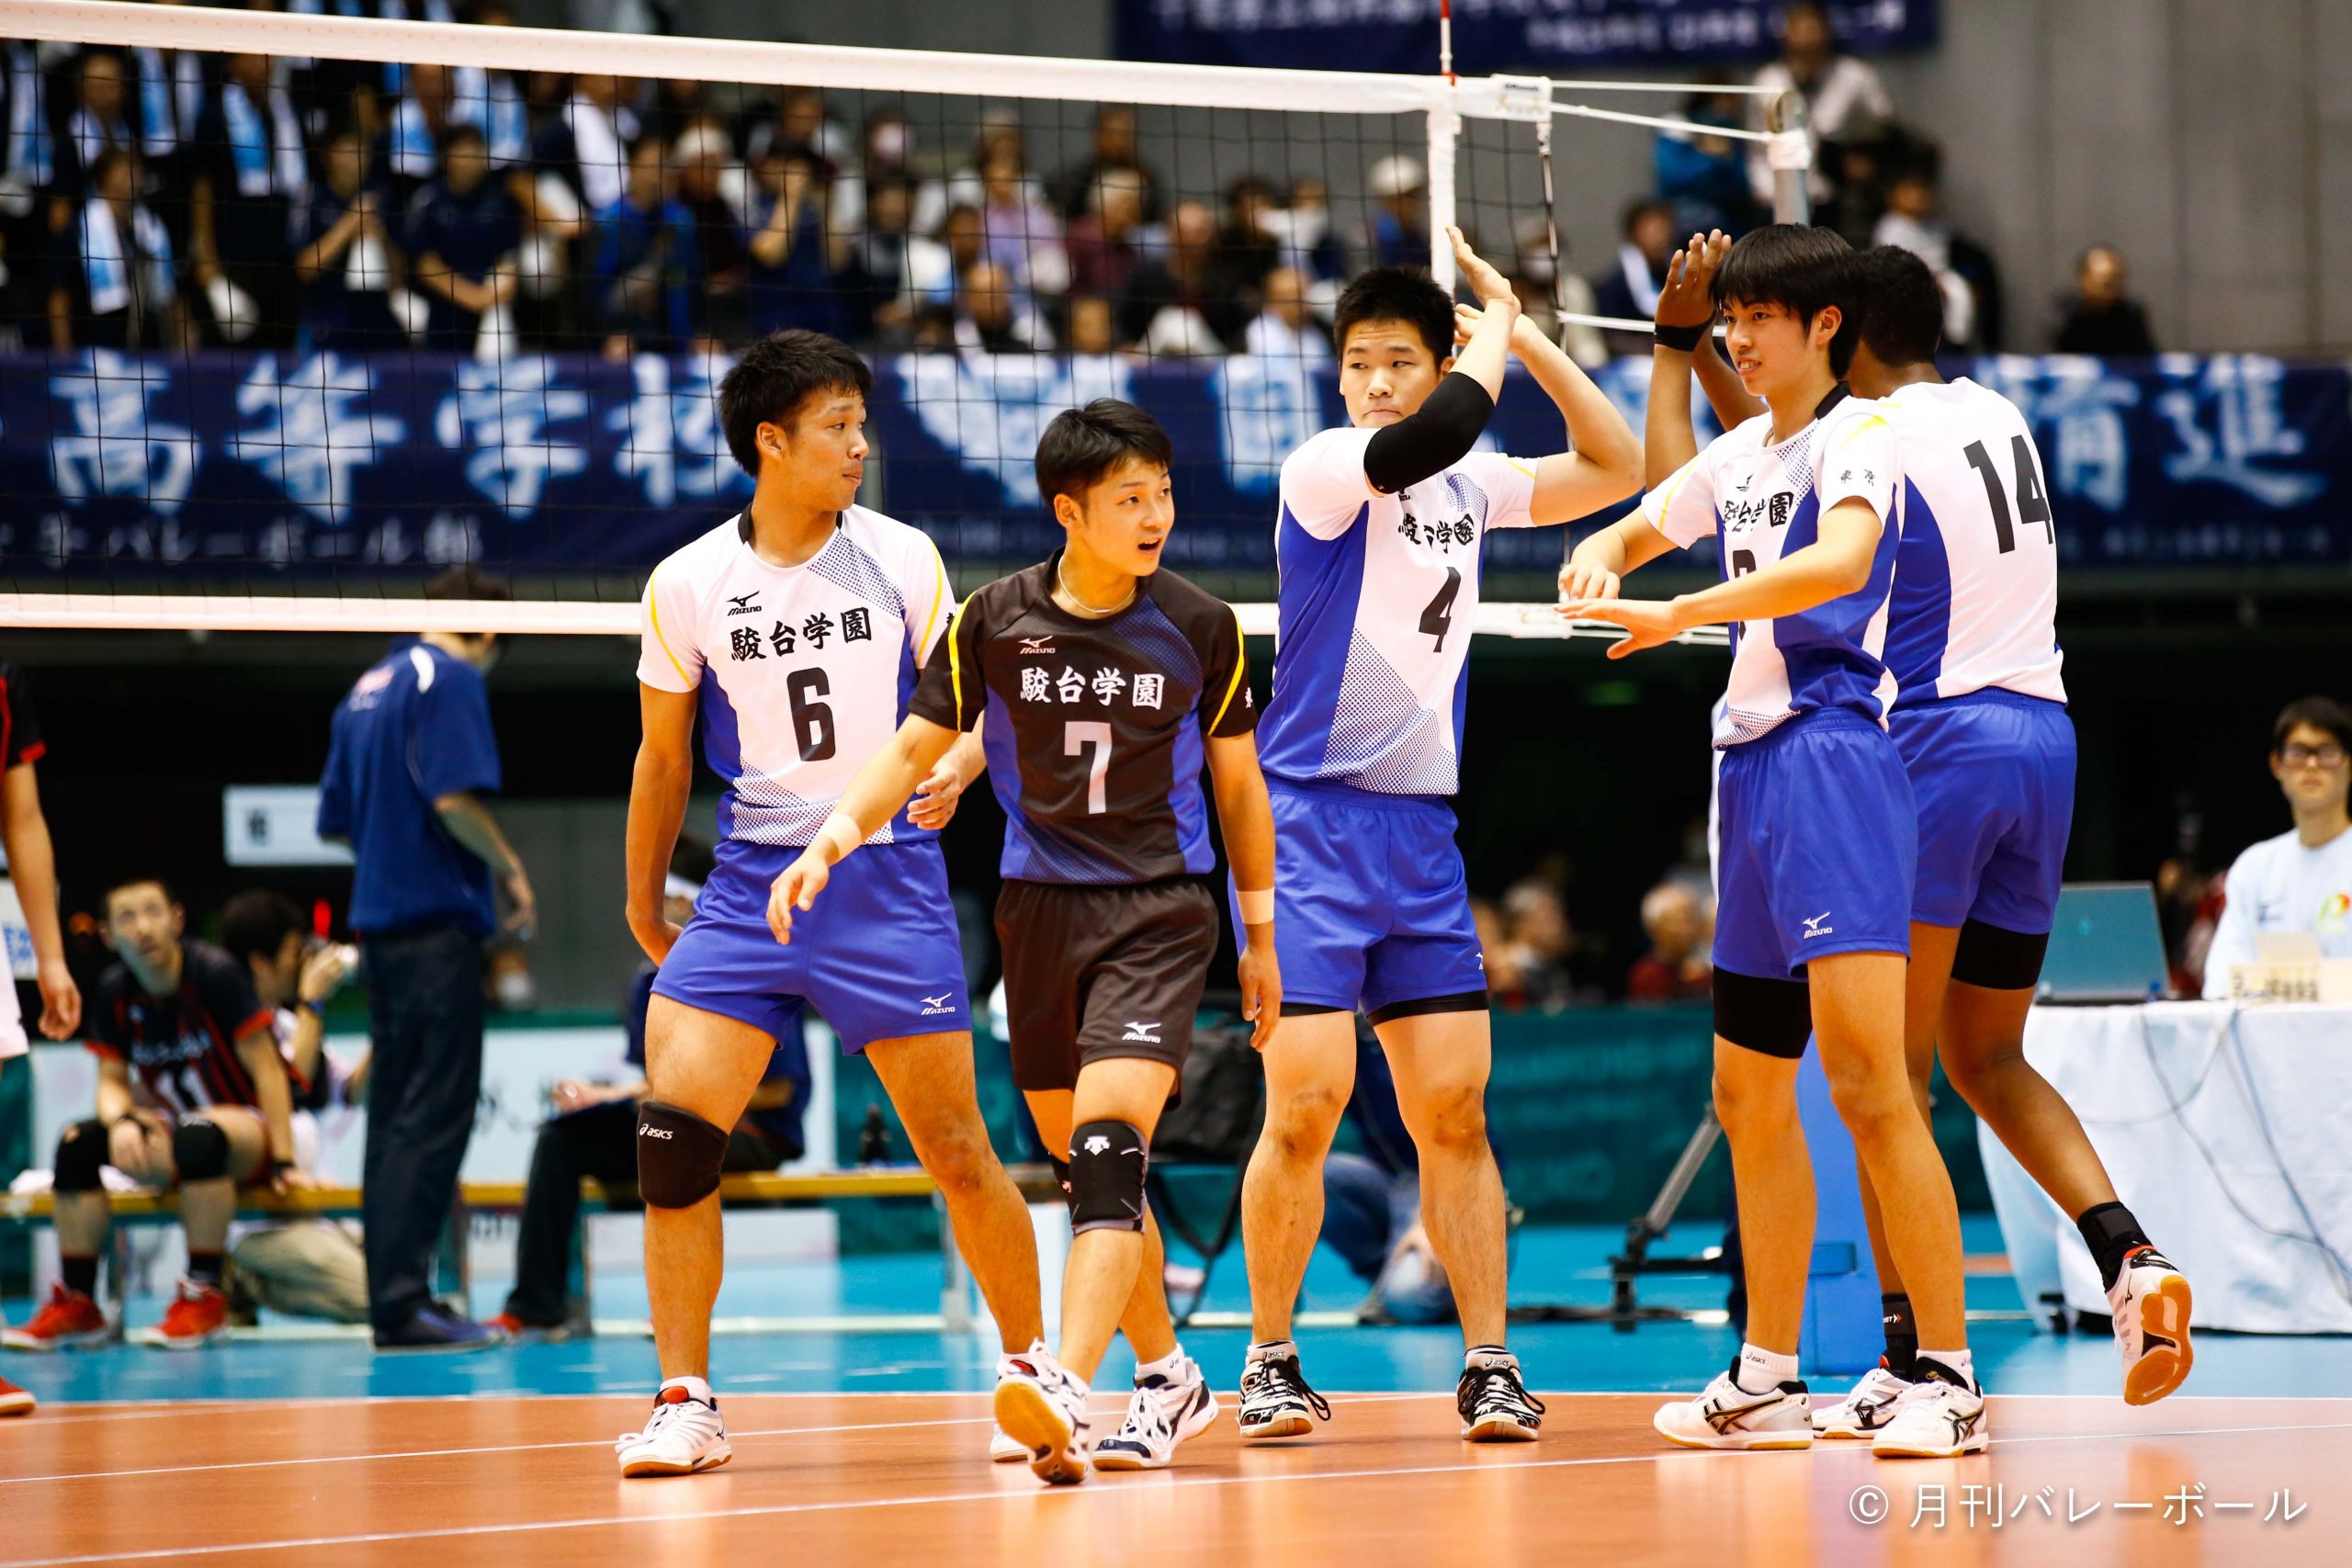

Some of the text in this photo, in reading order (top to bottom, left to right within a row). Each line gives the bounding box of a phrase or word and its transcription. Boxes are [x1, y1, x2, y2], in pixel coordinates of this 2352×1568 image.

[1963, 434, 2053, 553] 14
[729, 606, 872, 661] 駿台学園
[1419, 566, 1462, 655] 4
[786, 667, 836, 761] 6
[1020, 665, 1165, 710] 駿台学園
[1064, 721, 1114, 815] 7
[646, 1127, 673, 1140] asics
